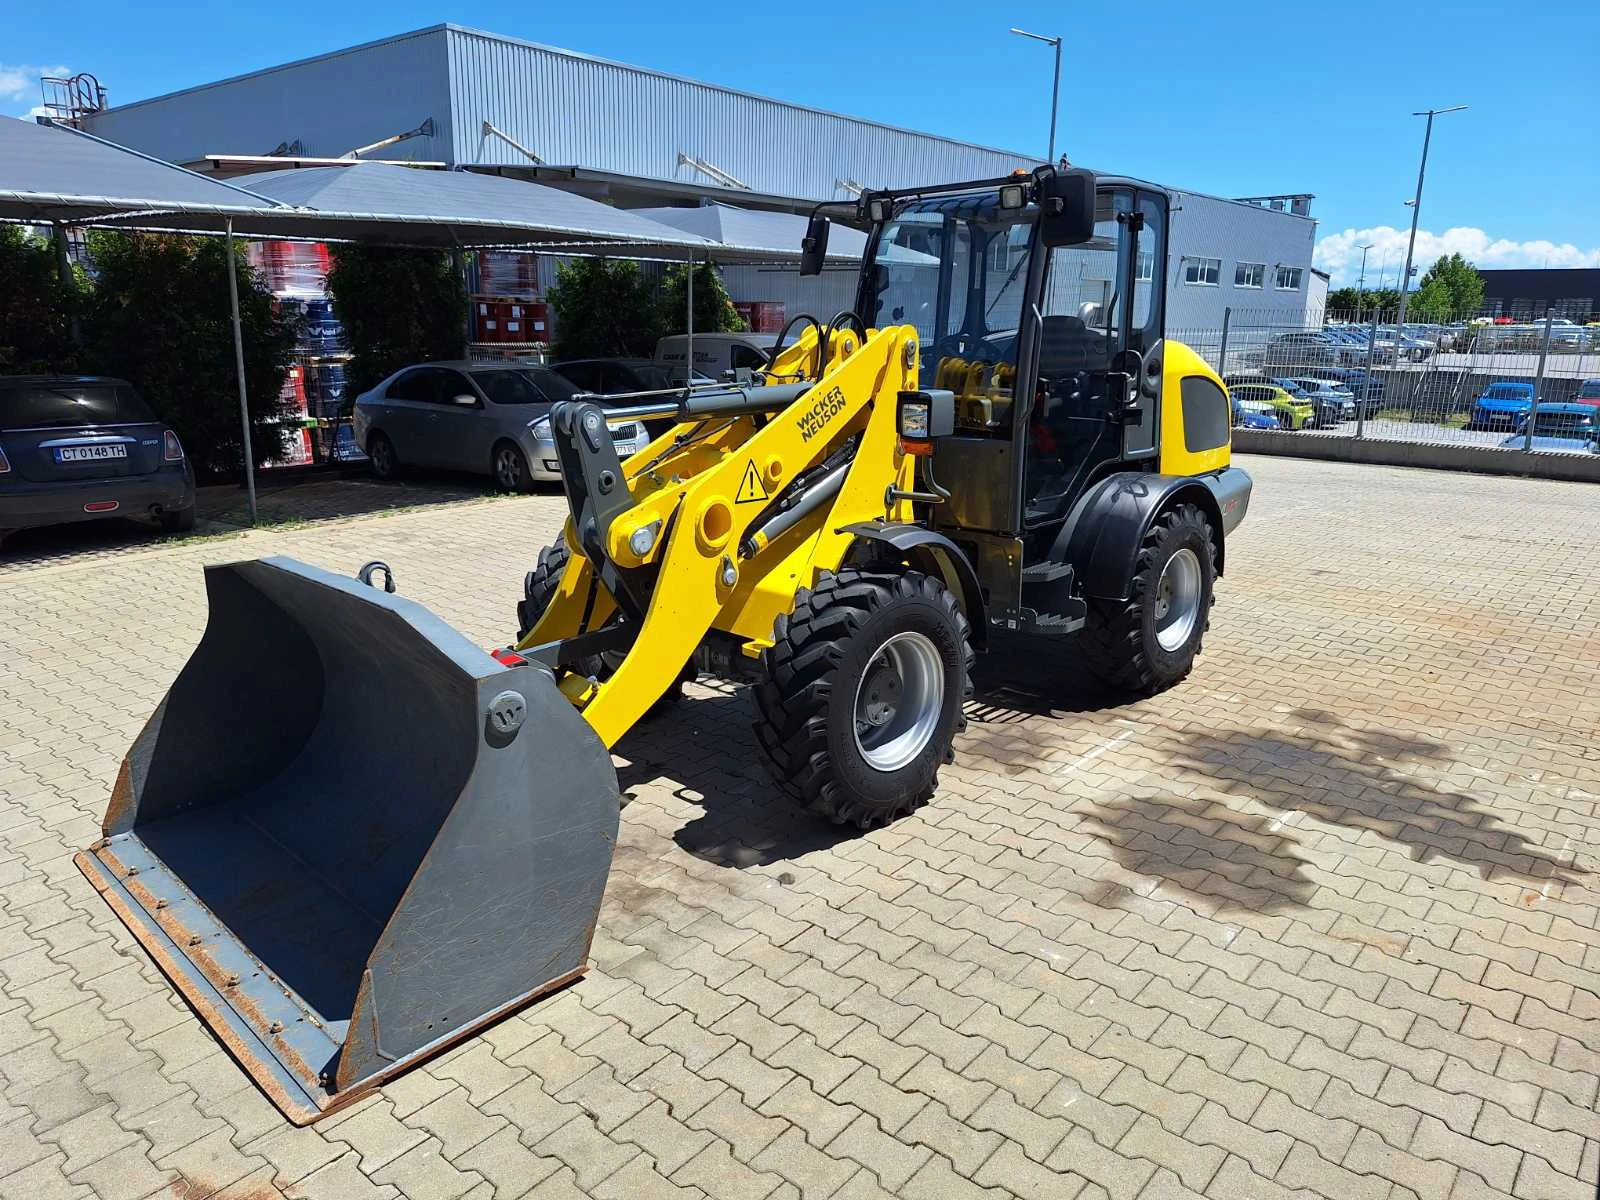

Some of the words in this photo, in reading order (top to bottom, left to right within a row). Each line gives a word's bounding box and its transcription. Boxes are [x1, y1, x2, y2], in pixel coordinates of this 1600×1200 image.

[796, 385, 842, 430] WACKER
[802, 396, 846, 443] NEUSON
[62, 447, 78, 460] CT
[80, 446, 108, 458] 0148
[110, 445, 126, 456] TH
